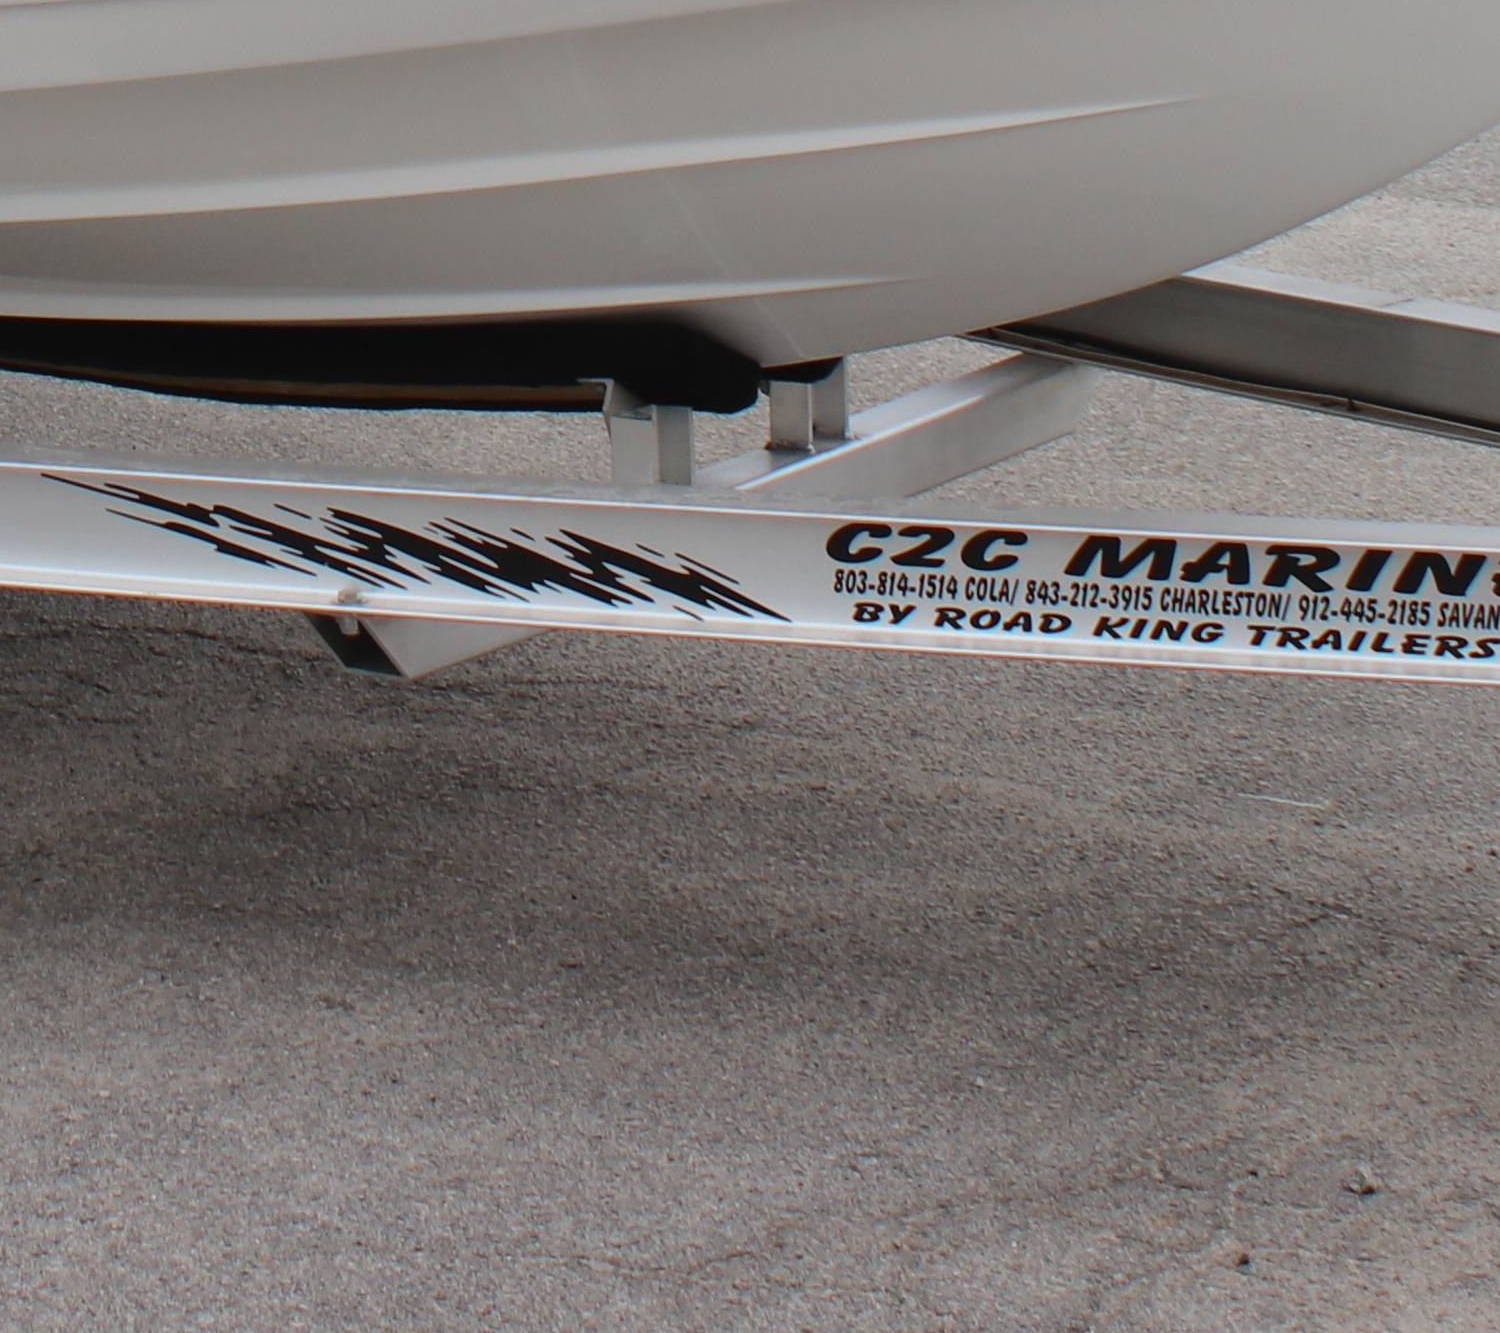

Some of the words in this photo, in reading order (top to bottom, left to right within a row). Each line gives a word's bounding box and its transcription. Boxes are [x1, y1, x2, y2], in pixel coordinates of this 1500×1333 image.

[826, 523, 1028, 571] C2C
[833, 568, 958, 600] 803-814-1514
[964, 577, 1020, 606] COLA/
[1024, 580, 1154, 611] 843-212-3915
[1160, 587, 1292, 621] CHARLESTON/
[1299, 596, 1432, 626] 912-445-2185
[852, 602, 917, 625] BY
[934, 606, 1073, 635] ROAD
[1092, 615, 1225, 643] KING
